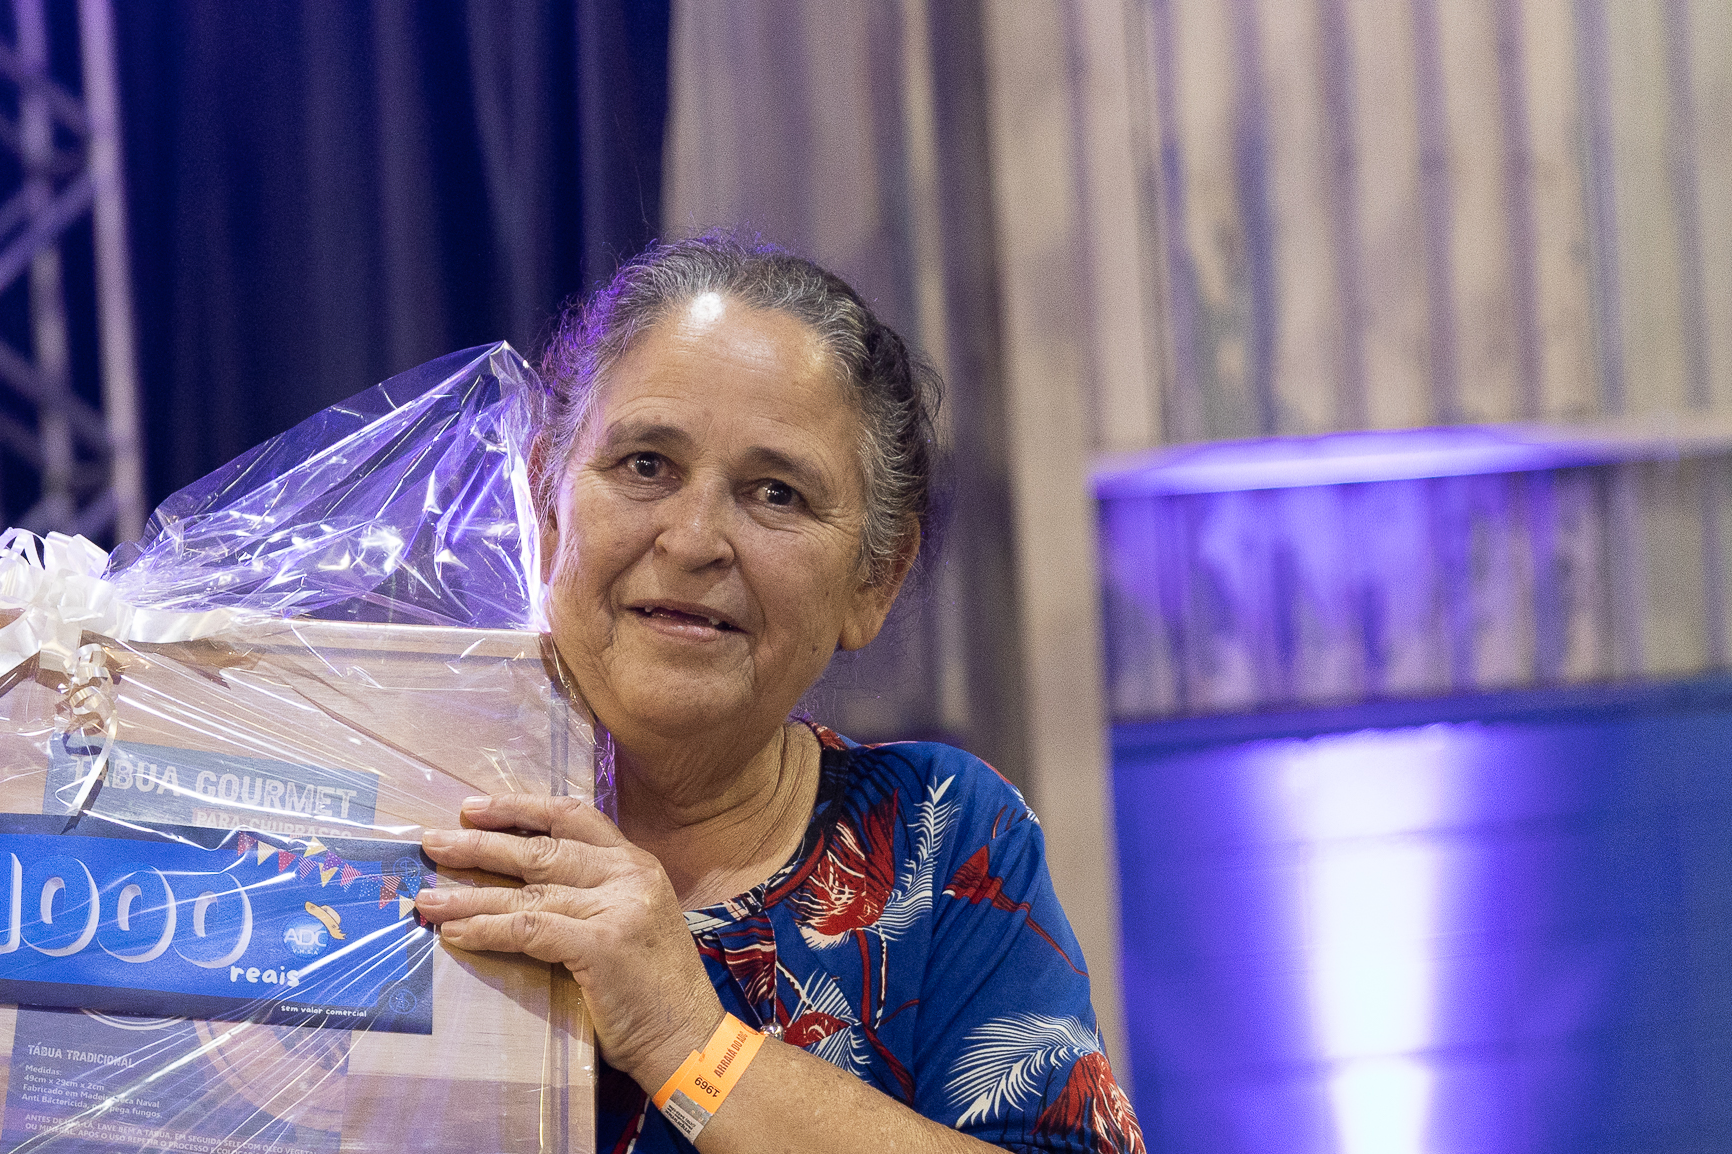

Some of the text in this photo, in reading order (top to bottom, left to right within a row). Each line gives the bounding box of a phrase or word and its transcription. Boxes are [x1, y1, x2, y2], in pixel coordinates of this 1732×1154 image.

[195, 770, 357, 819] GOURMET
[283, 927, 328, 947] ADC
[230, 965, 300, 988] reais
[281, 1004, 367, 1018] sem valor comercial
[27, 1041, 134, 1068] TÁBUA TRADICIONAL
[713, 1047, 738, 1078] ARRAIÁ
[730, 1039, 743, 1052] DO
[24, 1074, 47, 1084] 49cm
[56, 1078, 78, 1089] 29cm
[87, 1082, 105, 1092] 2cm
[25, 1064, 62, 1076] Medidas:
[23, 1083, 63, 1096] Fabricado
[80, 1091, 115, 1102] Madeir
[136, 1098, 161, 1109] Naval
[694, 1076, 721, 1098] 1969
[21, 1093, 40, 1102] Anti
[109, 1106, 131, 1116] pega
[132, 1106, 164, 1119] fungos.
[24, 1113, 51, 1123] ANTES
[96, 1122, 117, 1132] LAVE
[136, 1128, 144, 1136] A
[187, 1134, 222, 1147] SEGUIDA
[242, 1142, 261, 1151] COM
[25, 1122, 38, 1131] OU
[109, 1133, 127, 1141] USO
[168, 1141, 209, 1154] PROCESSO
